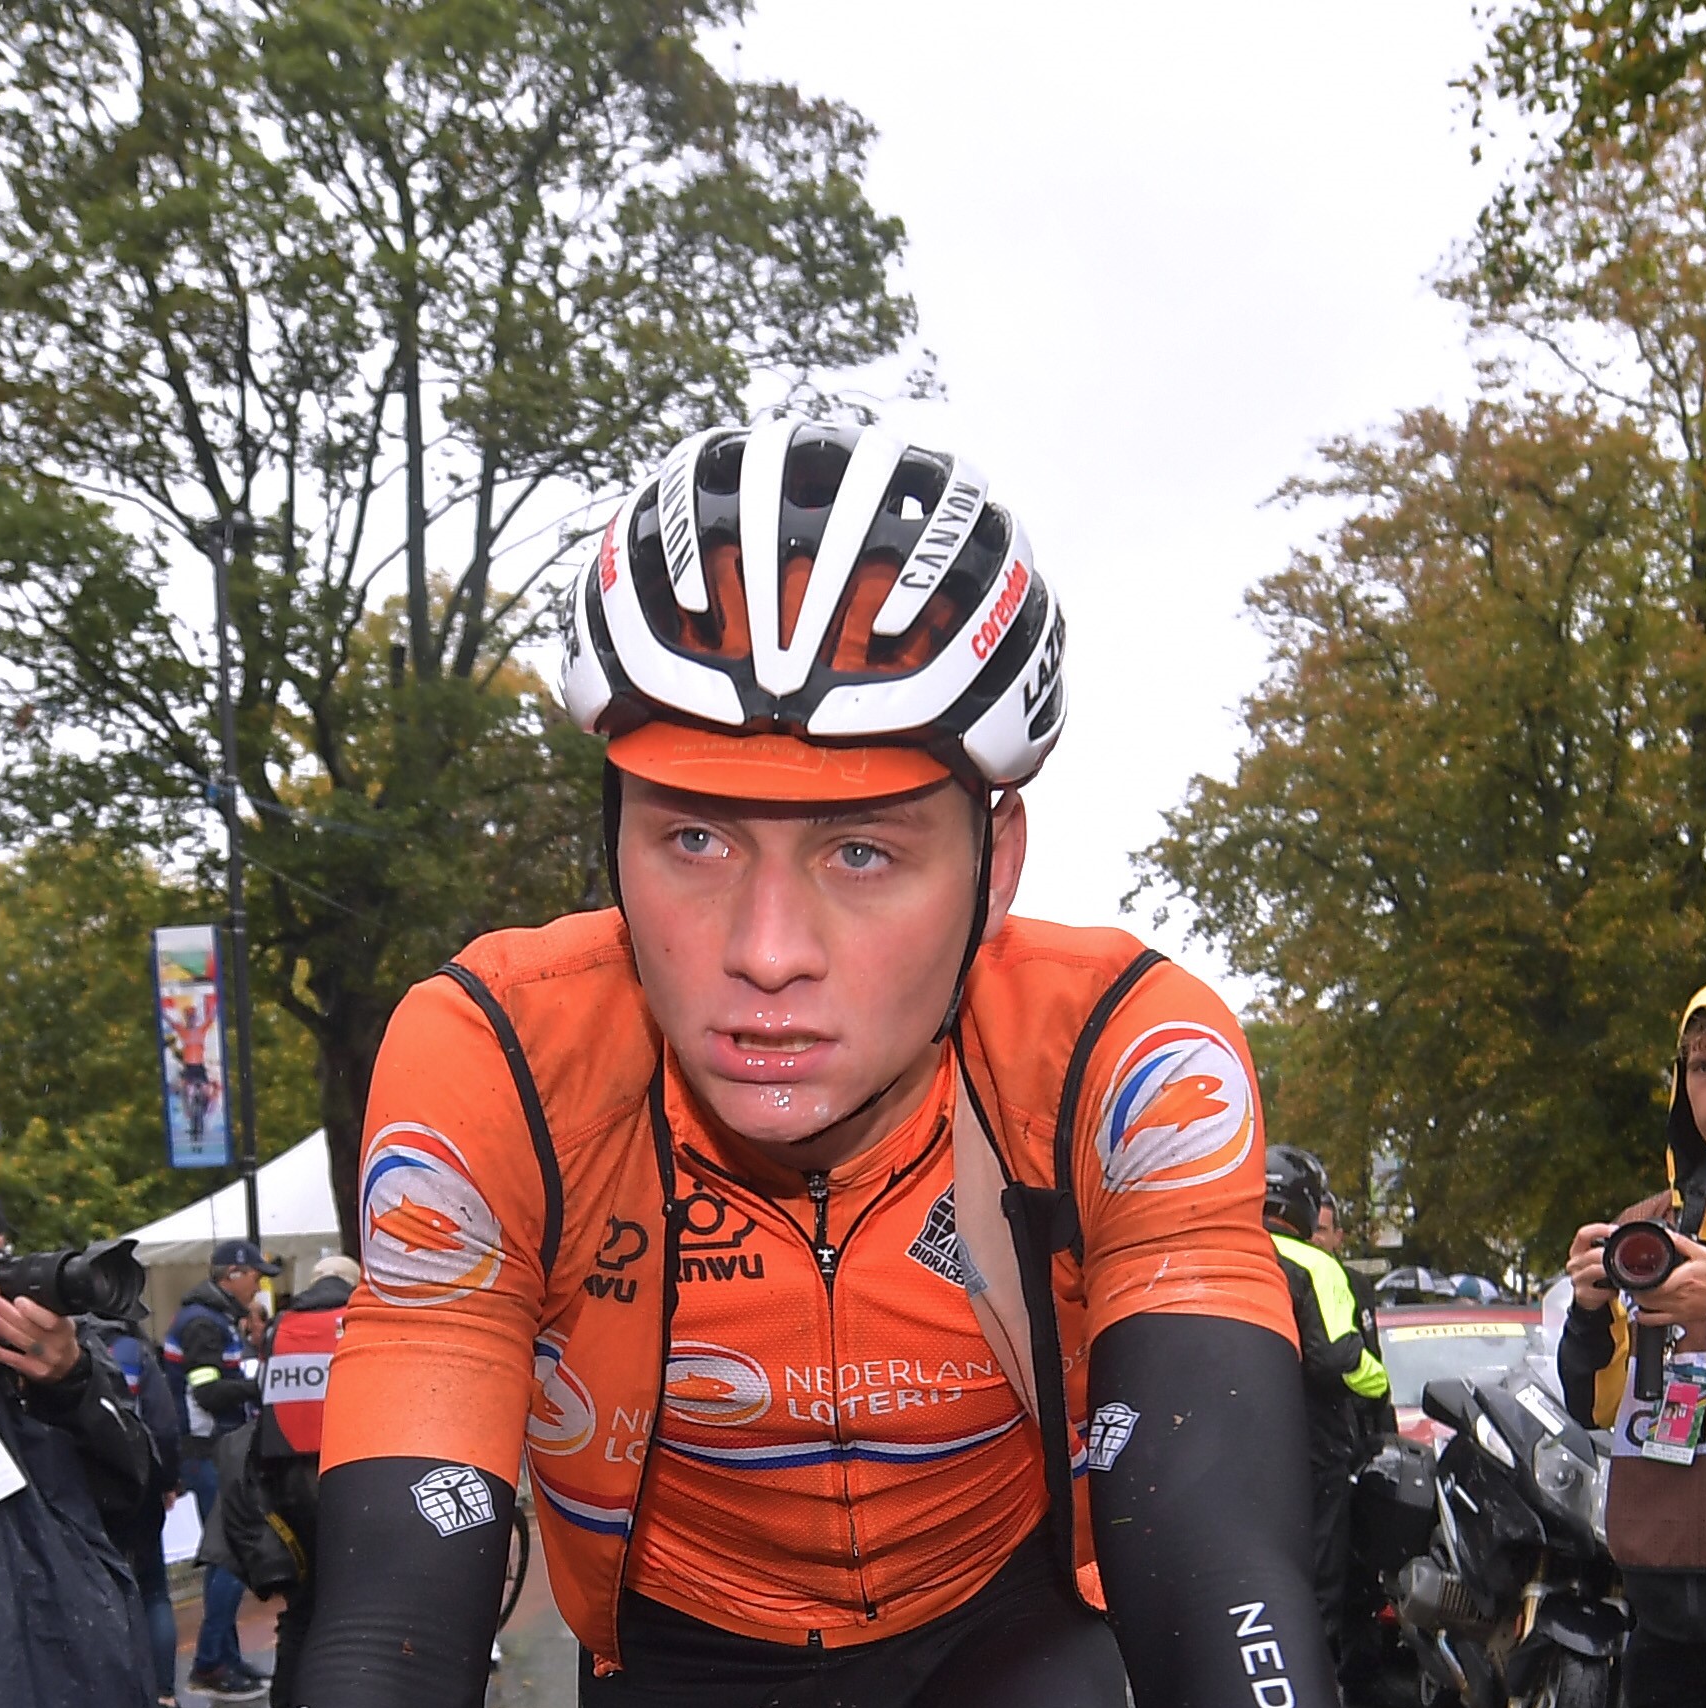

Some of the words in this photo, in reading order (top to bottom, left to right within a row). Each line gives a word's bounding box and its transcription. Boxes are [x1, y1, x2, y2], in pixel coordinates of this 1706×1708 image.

[661, 452, 694, 586] ANYON
[900, 480, 980, 589] CANYON
[971, 559, 1028, 661] corendon
[676, 1253, 765, 1283] nwu
[907, 1241, 965, 1286] BIORACE
[1415, 1325, 1500, 1337] OFFICIAL
[269, 1366, 329, 1389] PHO
[784, 1359, 995, 1395] NEDERLAN
[787, 1386, 962, 1426] LOTERIJ
